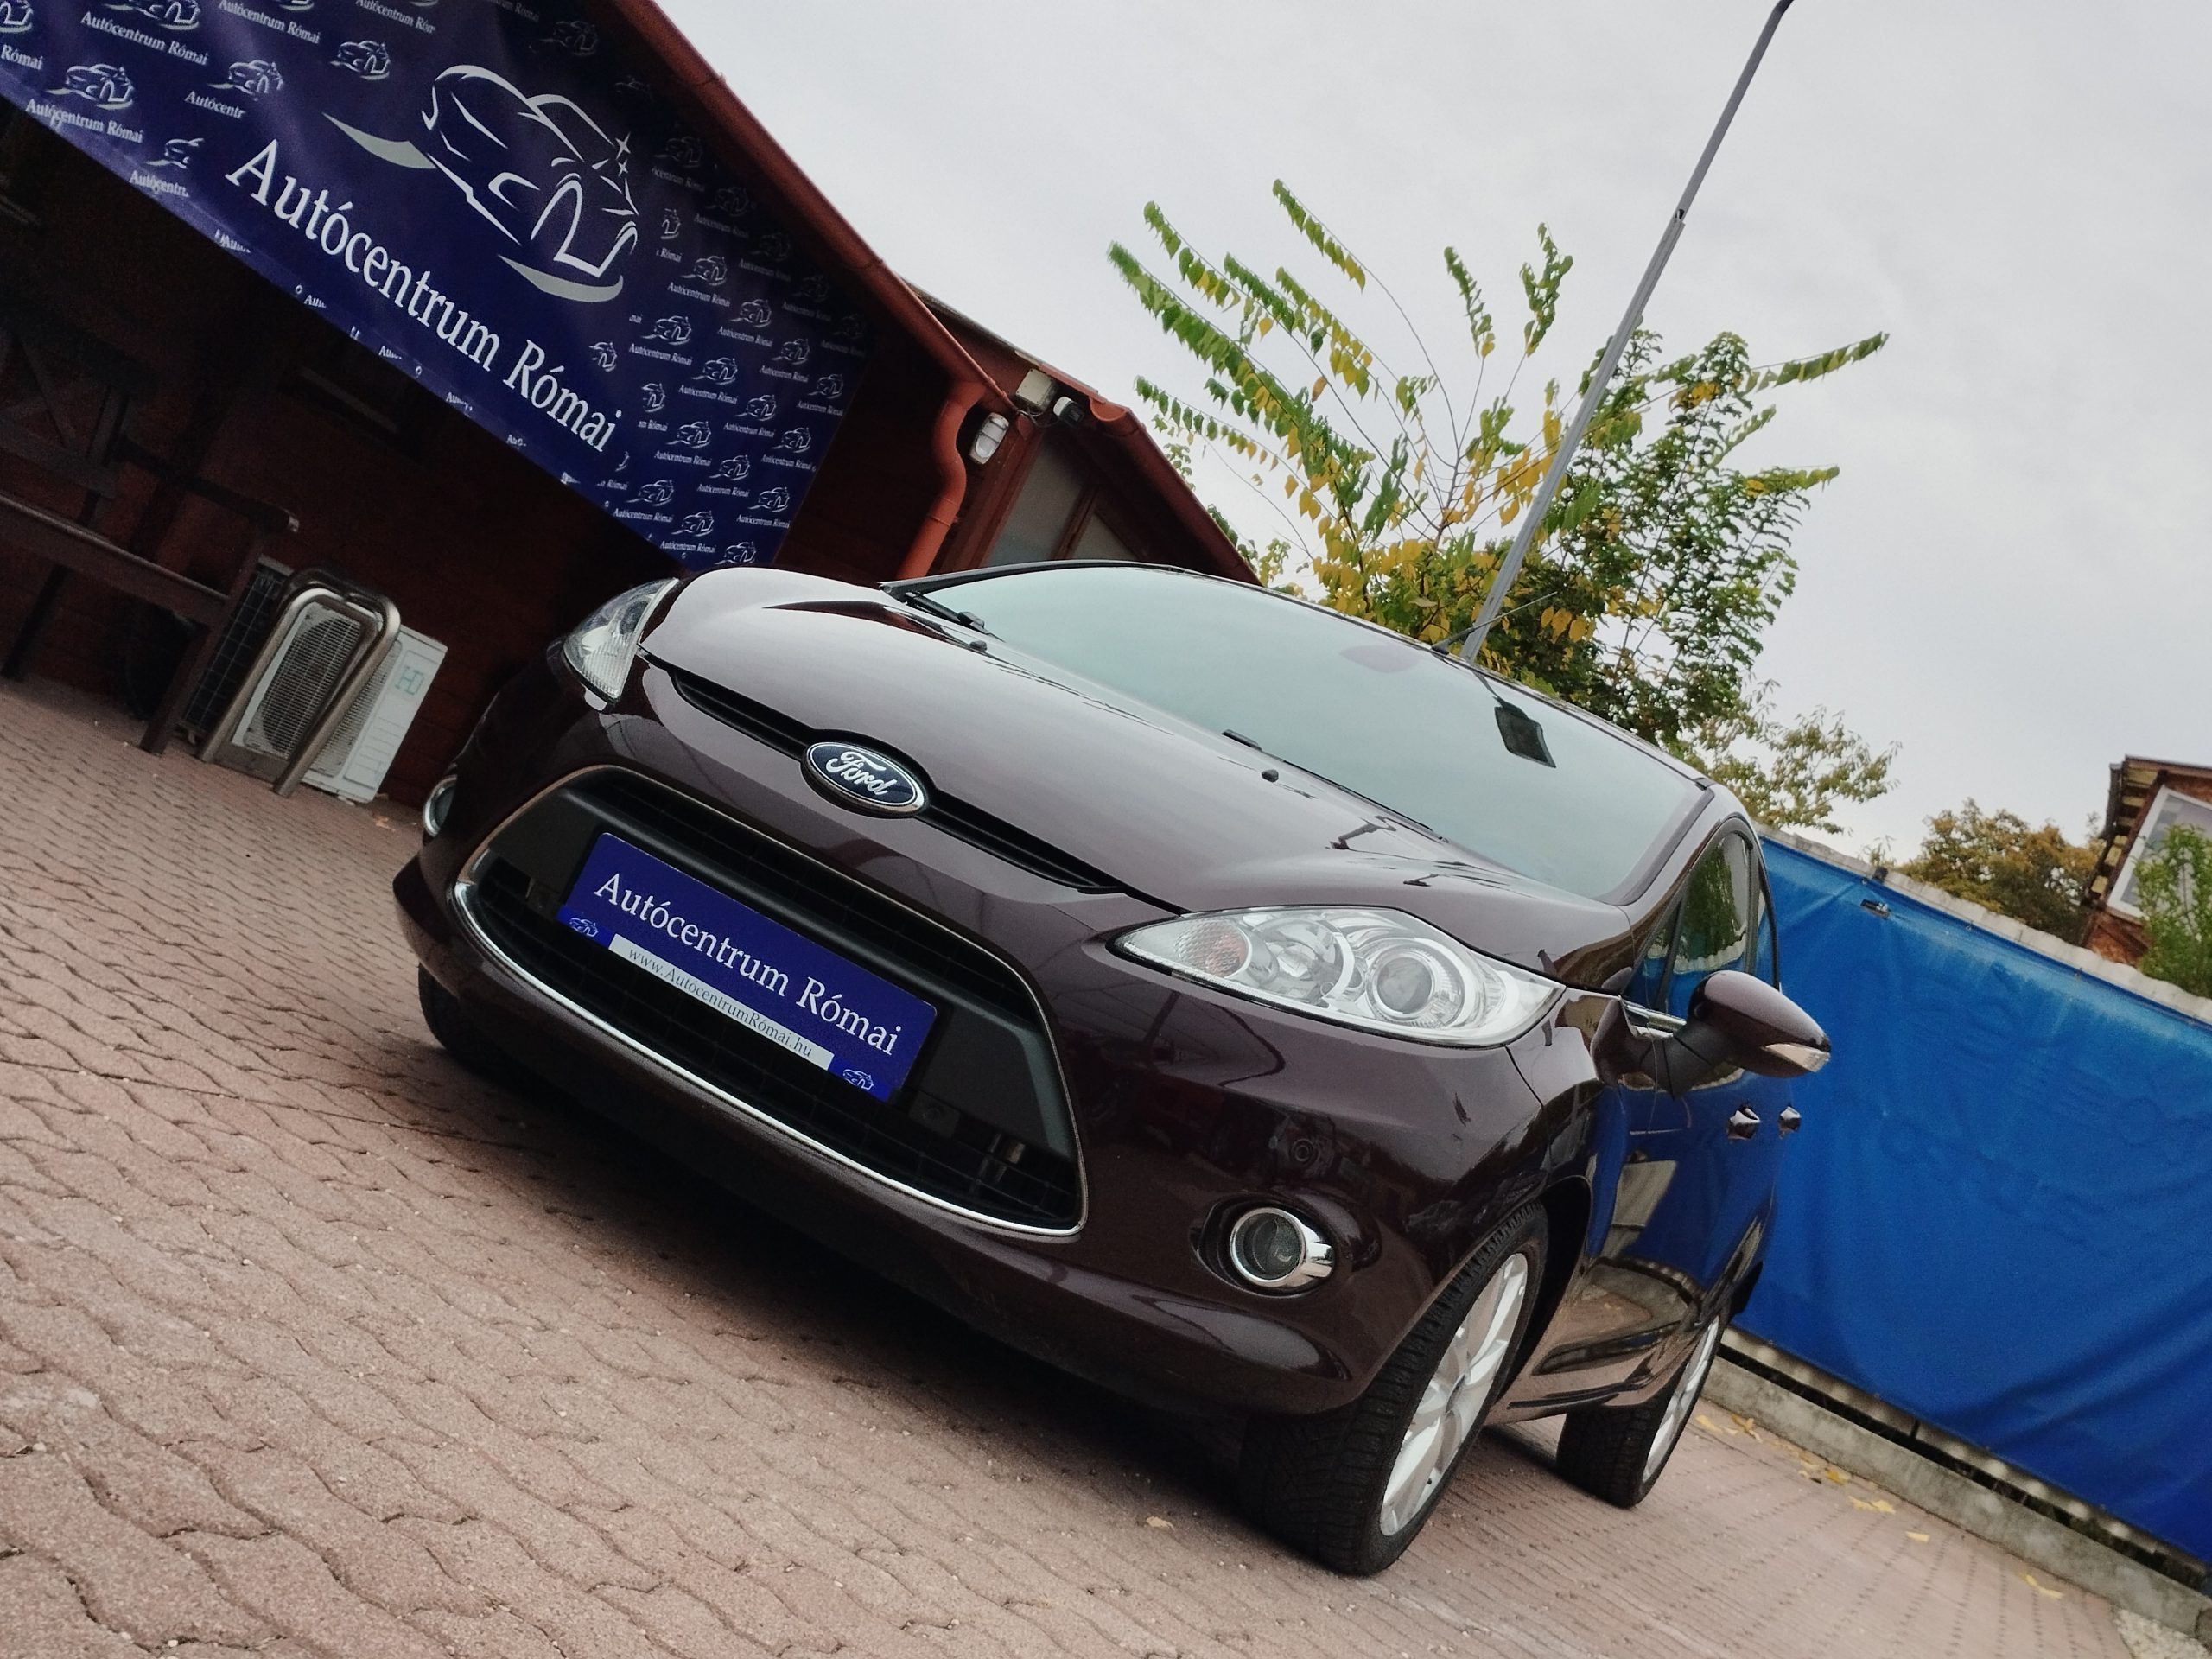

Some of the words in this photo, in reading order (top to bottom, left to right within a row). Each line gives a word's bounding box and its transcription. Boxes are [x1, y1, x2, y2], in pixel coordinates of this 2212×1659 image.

[79, 10, 165, 51] Autócentrum
[168, 41, 208, 66] Római
[287, 21, 321, 44] Római
[1, 44, 43, 70] Római
[107, 120, 143, 143] Római
[225, 138, 501, 372] Autócentrum
[503, 339, 622, 454] Római
[671, 352, 692, 366] Római
[825, 748, 889, 796] Ford
[594, 872, 790, 997] Autócentrum
[796, 976, 903, 1057] Római
[628, 946, 813, 1059] www.AutócentrumRómai.hu
